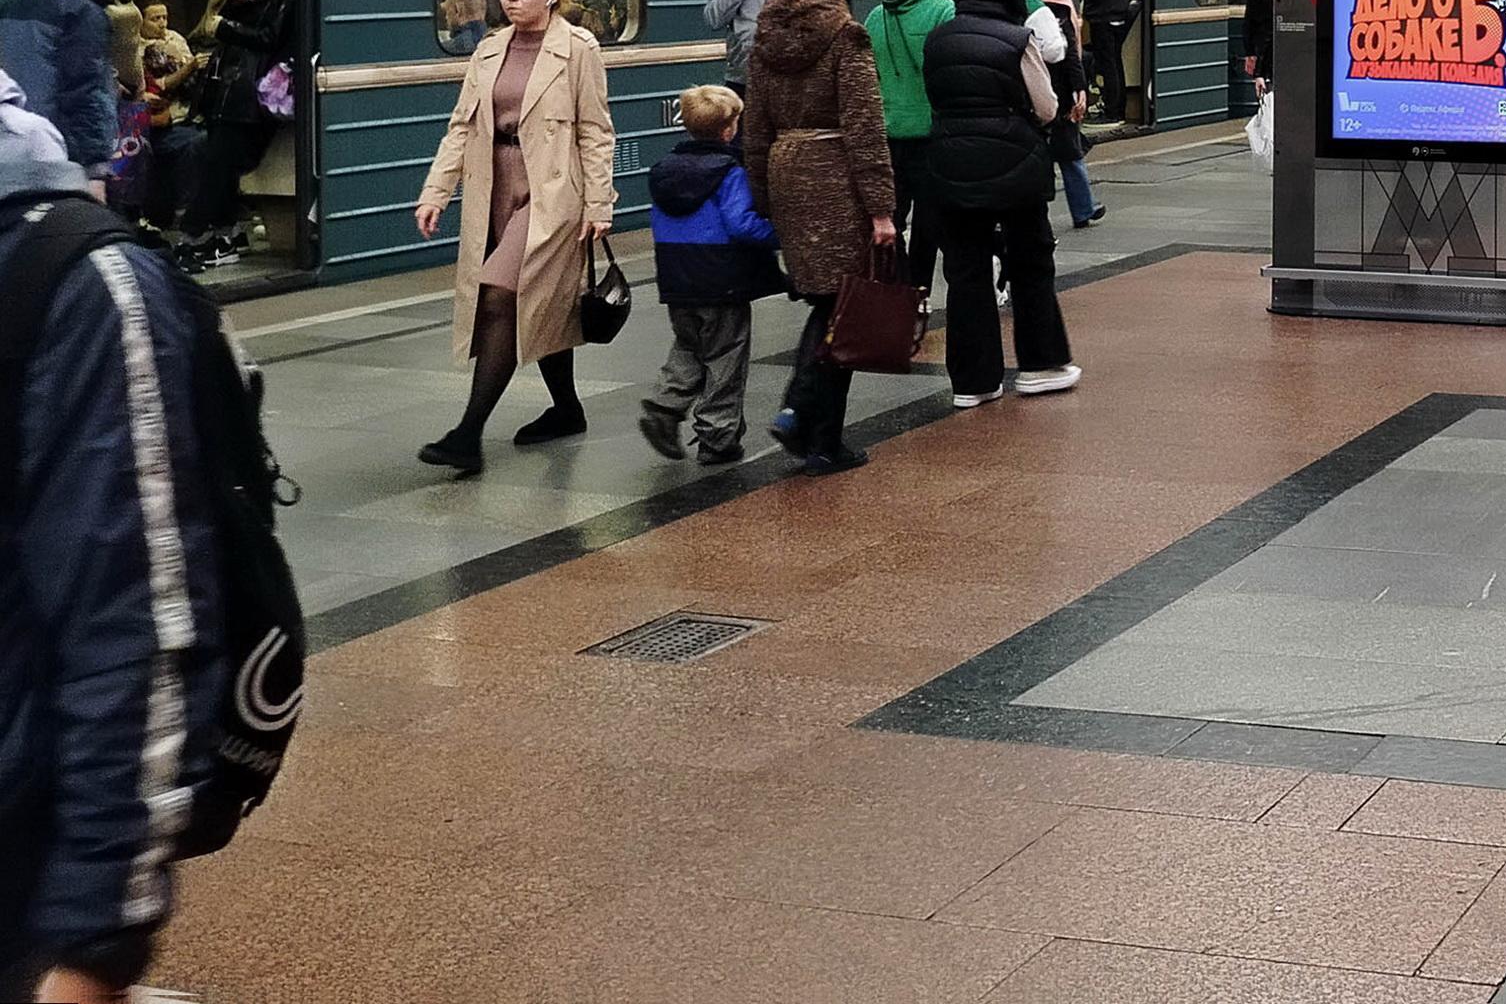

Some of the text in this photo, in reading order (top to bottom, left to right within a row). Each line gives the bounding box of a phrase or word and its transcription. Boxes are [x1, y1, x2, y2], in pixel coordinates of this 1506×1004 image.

[1350, 17, 1462, 62] СОБАКЕ
[1350, 60, 1504, 86] МУЗЫКАЛЬНАЯ КОМЕДИЯ
[1339, 117, 1363, 133] 12+
